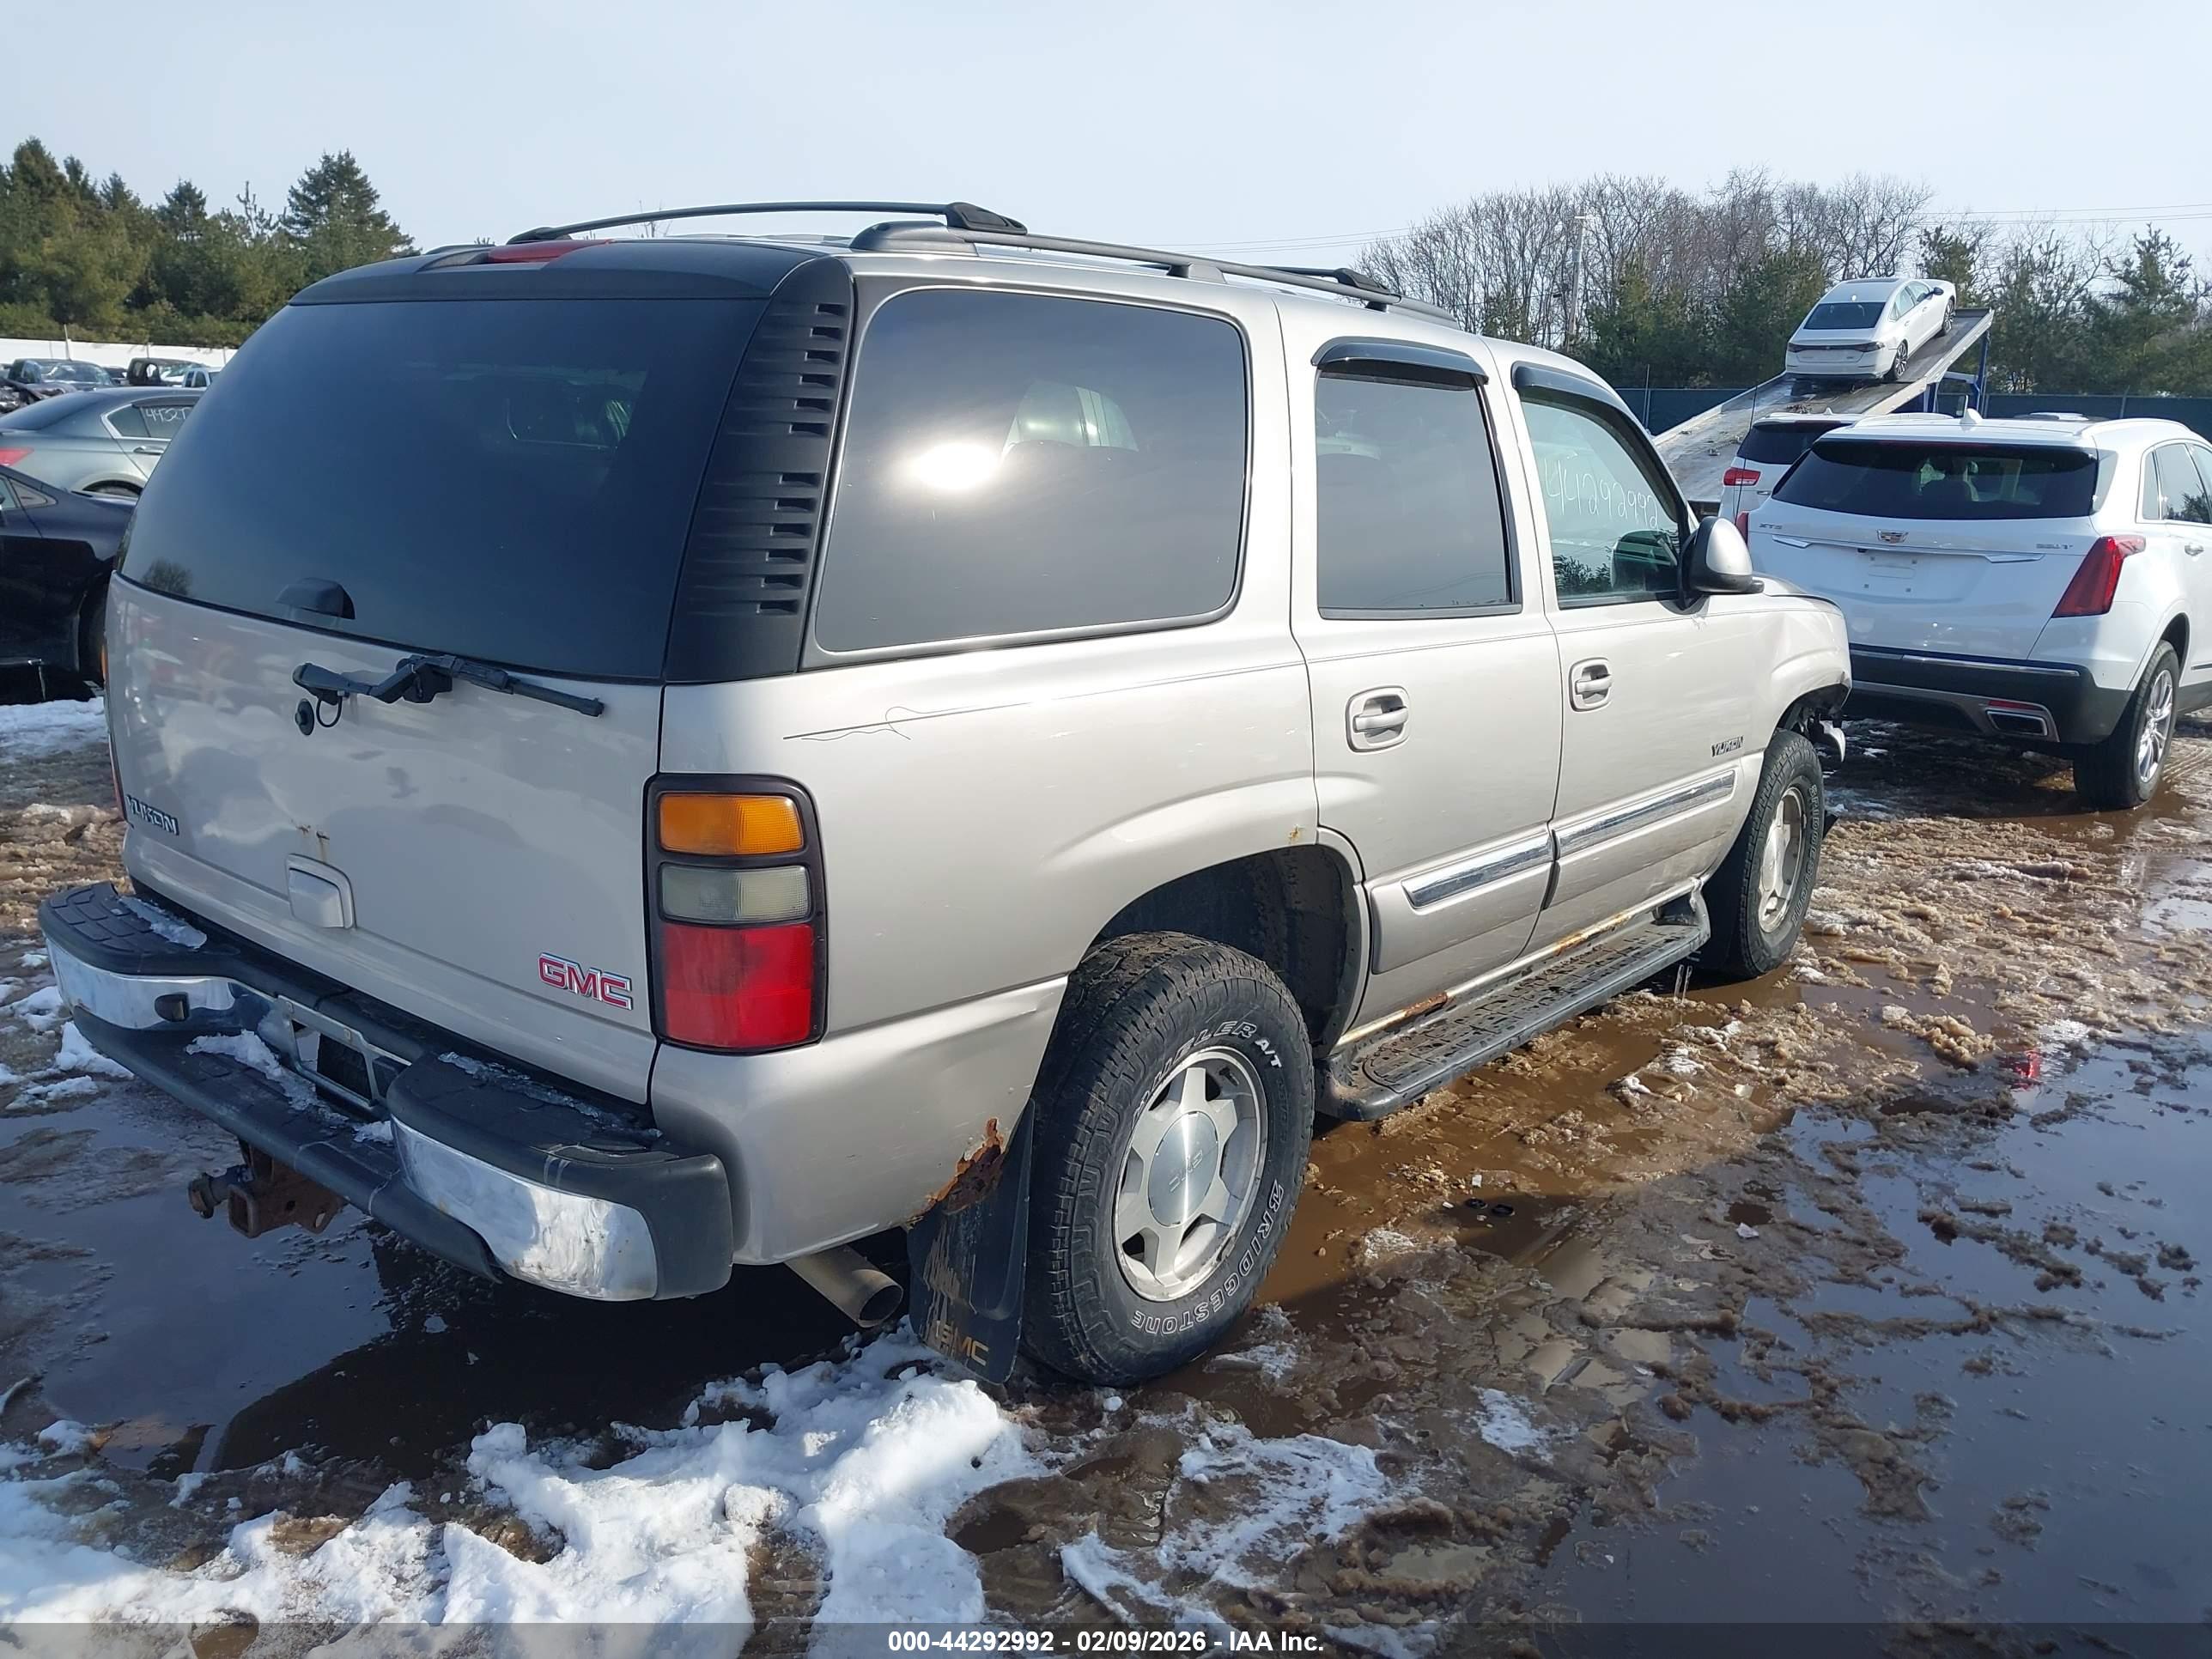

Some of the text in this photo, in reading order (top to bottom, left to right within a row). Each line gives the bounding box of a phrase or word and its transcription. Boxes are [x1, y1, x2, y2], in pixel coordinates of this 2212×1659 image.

[1545, 458, 1659, 531] 44292992
[1711, 736, 1743, 757] YUKON
[538, 951, 633, 1011] GMC
[1255, 1039, 1282, 1068] A/T
[1131, 1179, 1285, 1334] BRIDGESTONE
